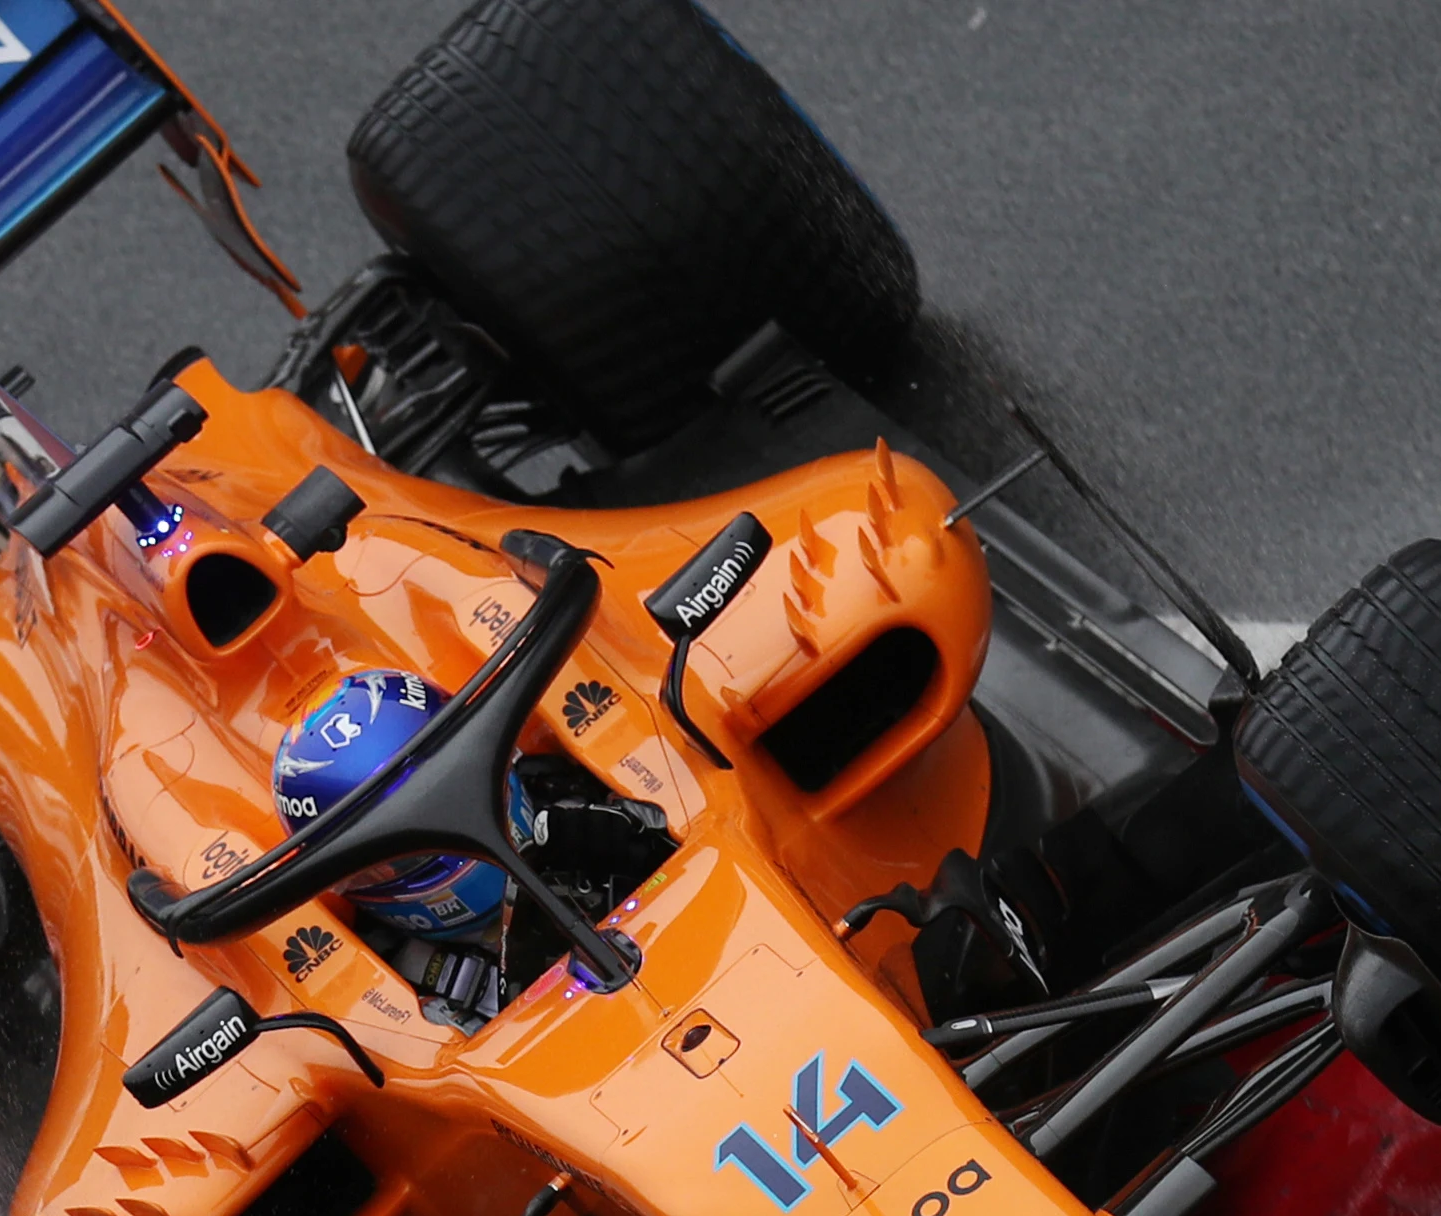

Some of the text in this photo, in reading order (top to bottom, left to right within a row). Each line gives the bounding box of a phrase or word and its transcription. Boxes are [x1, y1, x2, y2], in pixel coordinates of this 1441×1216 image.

[675, 558, 743, 628] Airgain
[468, 595, 521, 648] itech
[573, 691, 623, 739] CNBC
[278, 795, 319, 818] moa
[200, 830, 254, 881] logit
[294, 937, 344, 984] CNBC
[174, 1014, 247, 1079] Airgain
[714, 1049, 905, 1213] 14
